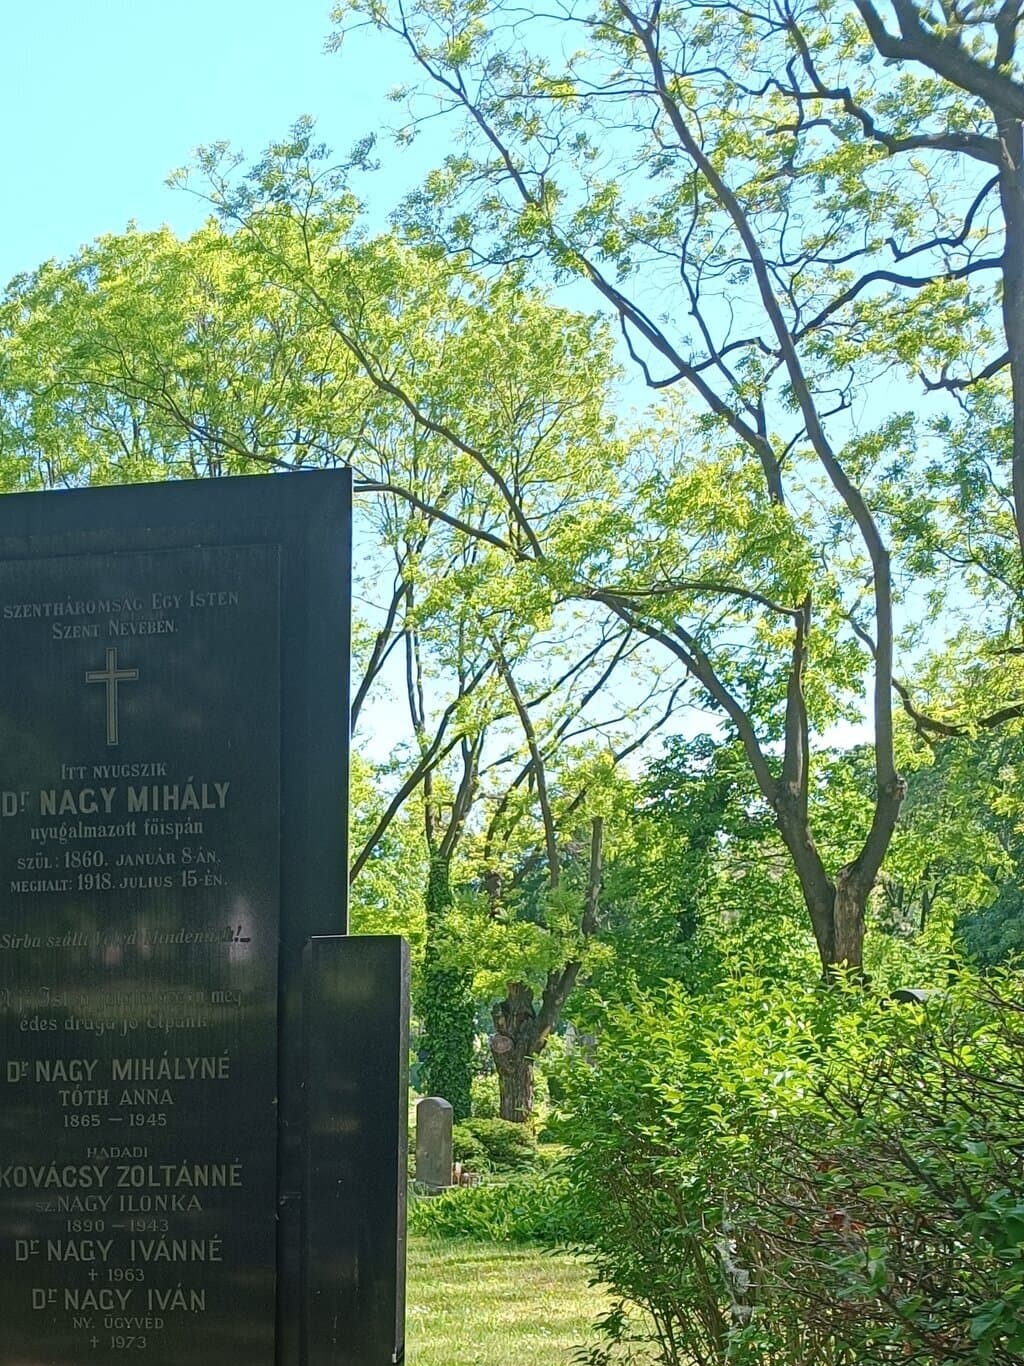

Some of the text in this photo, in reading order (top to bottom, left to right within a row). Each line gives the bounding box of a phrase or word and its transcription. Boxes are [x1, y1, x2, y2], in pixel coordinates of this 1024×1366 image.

[61, 762, 167, 780] ITT NYUGSZIK
[41, 787, 117, 815] NAGY
[127, 775, 231, 811] MIHÁLY
[30, 819, 137, 845] nyugalmazott
[20, 1015, 57, 1033] édes
[36, 1059, 99, 1082] NAGY
[112, 1049, 231, 1081] MIHÁLYNÉ
[59, 1084, 174, 1107] TÓTH ANNA
[63, 1114, 101, 1127] 1865
[129, 1113, 167, 1126] 1945
[87, 1147, 148, 1158] HADADI
[116, 1157, 243, 1187] ZOLTÁNNÉ
[57, 1194, 113, 1212] NAGY
[119, 1194, 203, 1212] ILONKA
[66, 1219, 105, 1233] 1890
[129, 1219, 169, 1232] 1943
[47, 1240, 114, 1262] NAGY
[130, 1235, 223, 1261] IVÁNNÉ
[108, 1268, 145, 1282] 1963
[65, 1289, 133, 1311] NAGY
[147, 1283, 207, 1311] IVÁN
[111, 1336, 147, 1349] 1973
